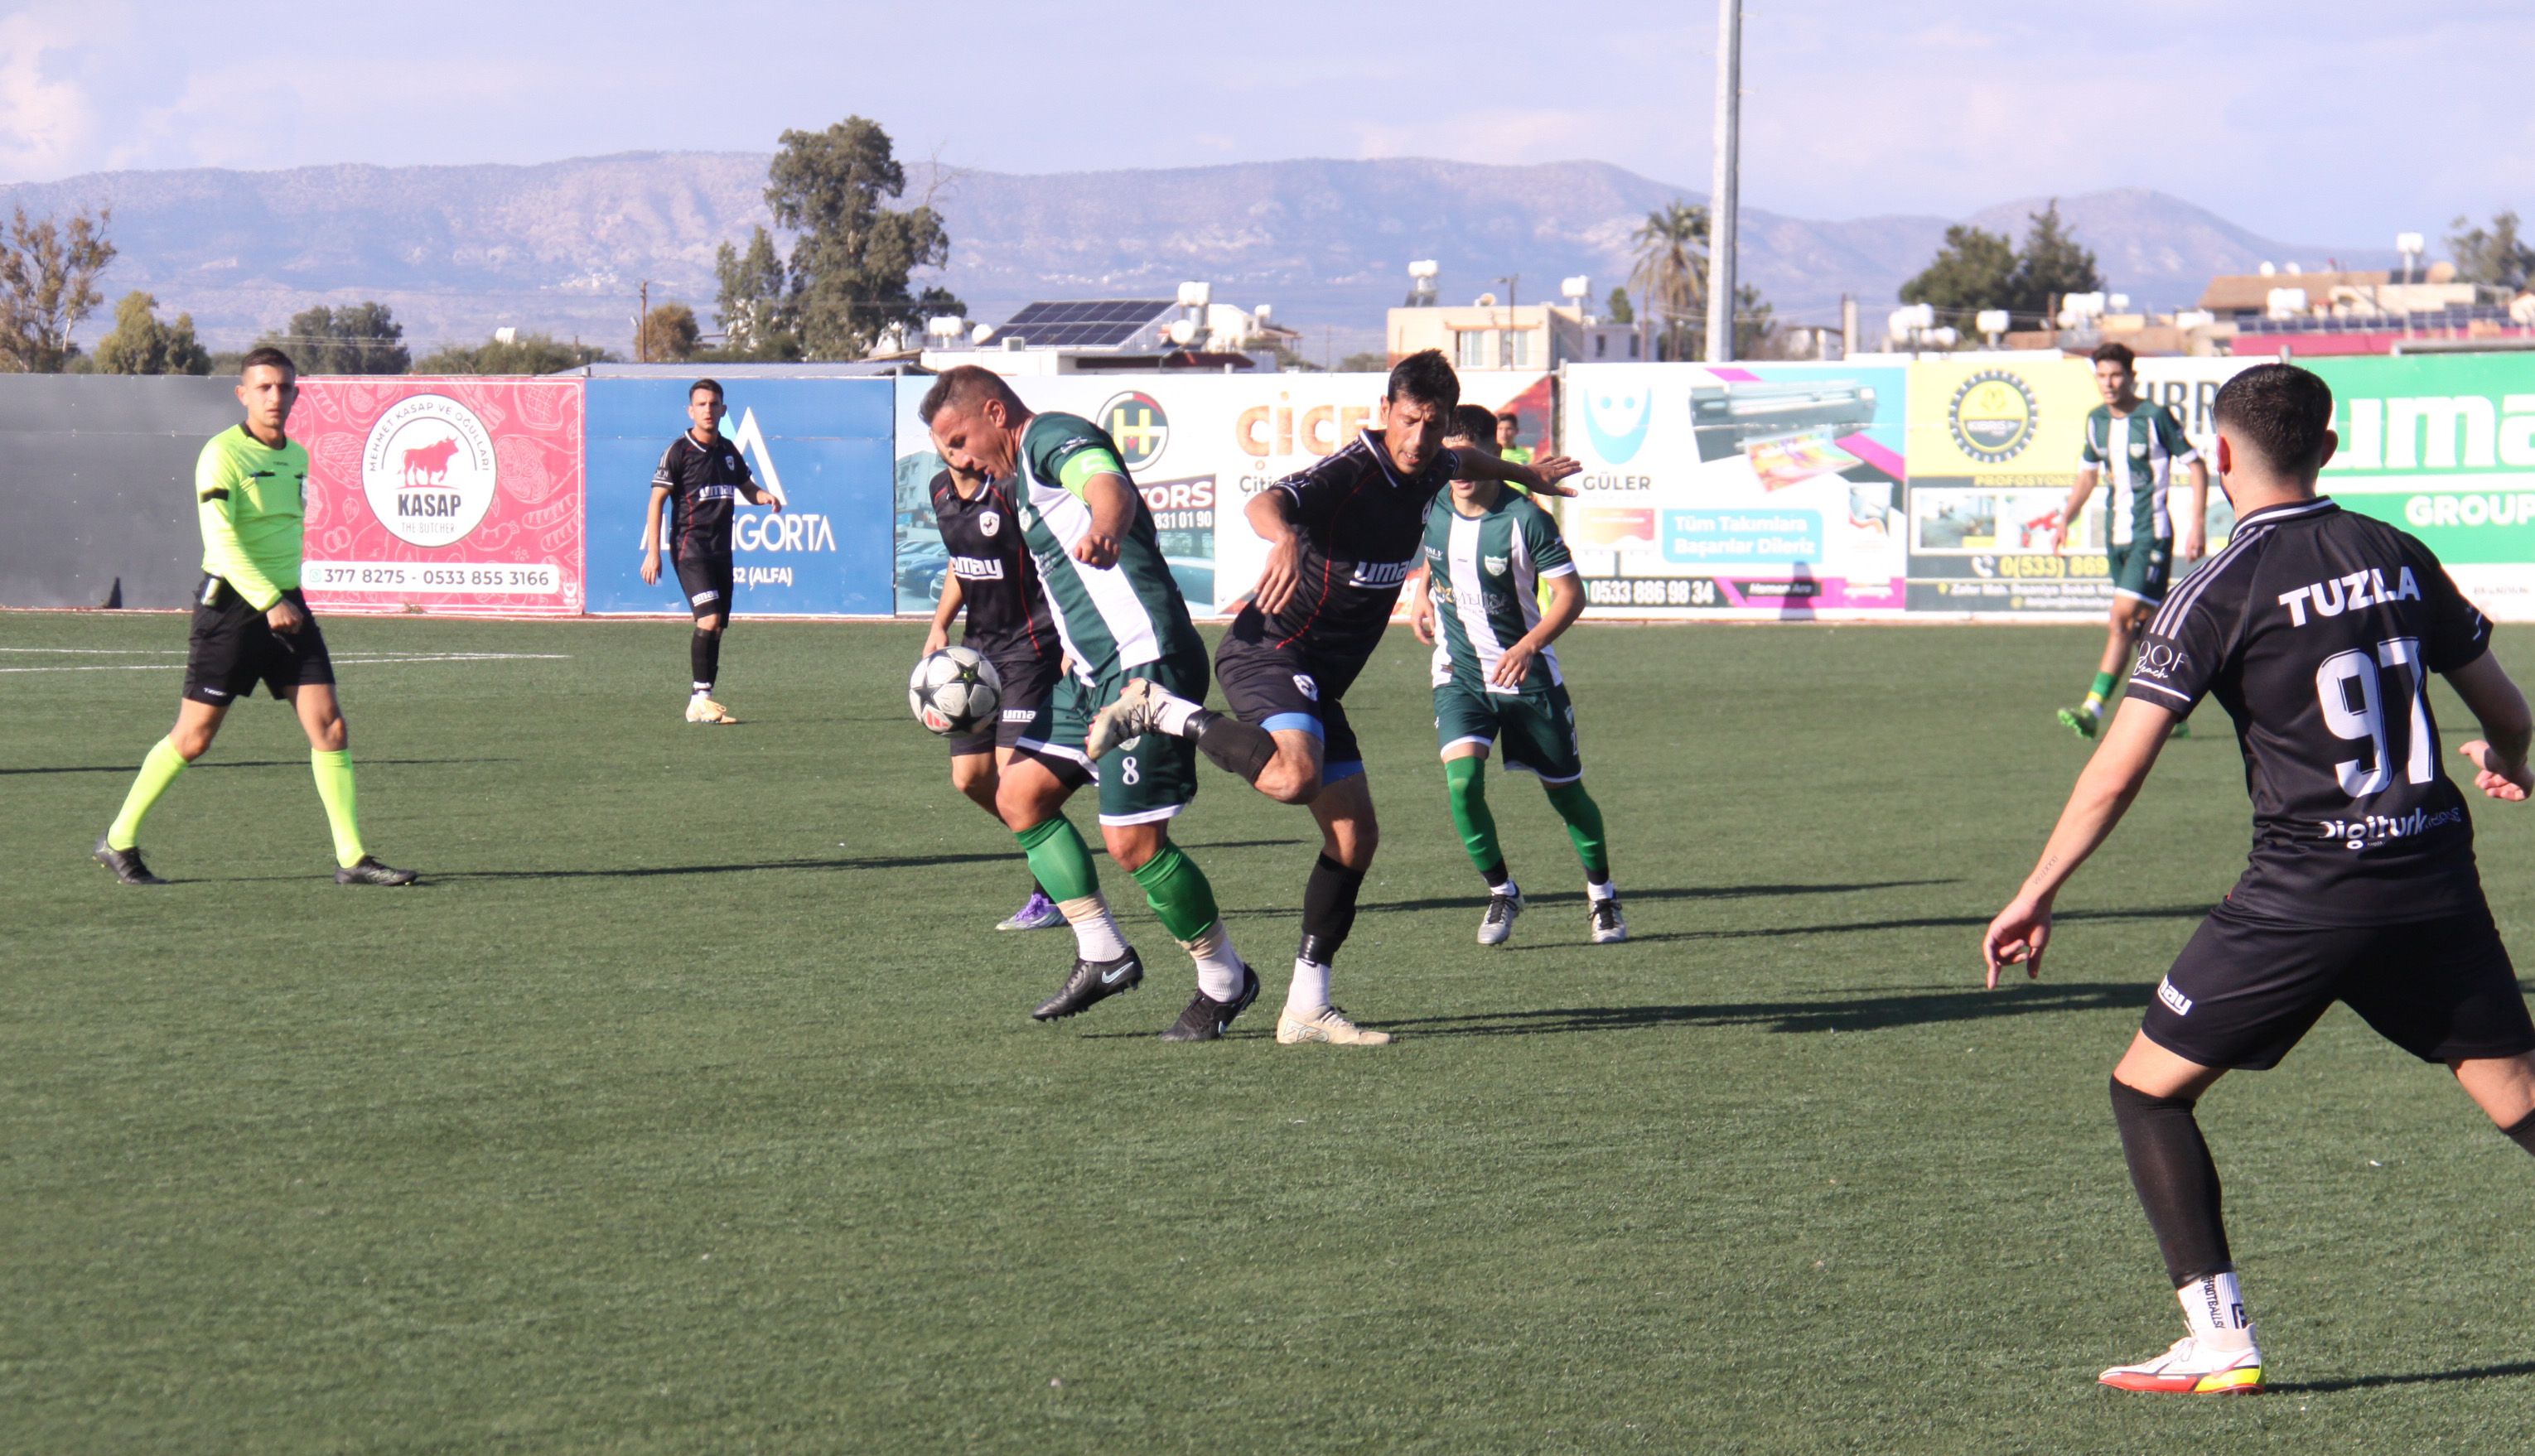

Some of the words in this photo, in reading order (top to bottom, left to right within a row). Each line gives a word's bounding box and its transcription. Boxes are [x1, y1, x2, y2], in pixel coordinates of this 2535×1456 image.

[369, 418, 394, 471] MEHMET
[395, 402, 434, 420] KASAP
[438, 403, 452, 415] VE
[455, 412, 490, 471] OĞULLARI
[1583, 472, 1651, 491] GÜLER
[398, 494, 461, 517] KASAP
[2405, 494, 2535, 527] GROUP
[402, 523, 416, 533] THE
[419, 523, 455, 533] BUTCHER
[732, 513, 836, 551] İGORTA
[1674, 515, 1717, 532] Tüm
[324, 569, 355, 583] 377
[362, 569, 405, 584] 8275
[423, 571, 466, 585] 0533
[471, 571, 503, 586] 855
[509, 571, 549, 586] 3166
[749, 566, 792, 588] (ALFA)
[1349, 560, 1411, 589] uma
[1590, 580, 1631, 604] 0533
[1668, 580, 1690, 604] 98
[1692, 580, 1715, 604] 34
[2278, 566, 2421, 627] TUZLA
[2132, 656, 2169, 678] Beach
[1002, 710, 1036, 722] uma
[2316, 637, 2434, 798] 97
[1123, 756, 1139, 785] 8
